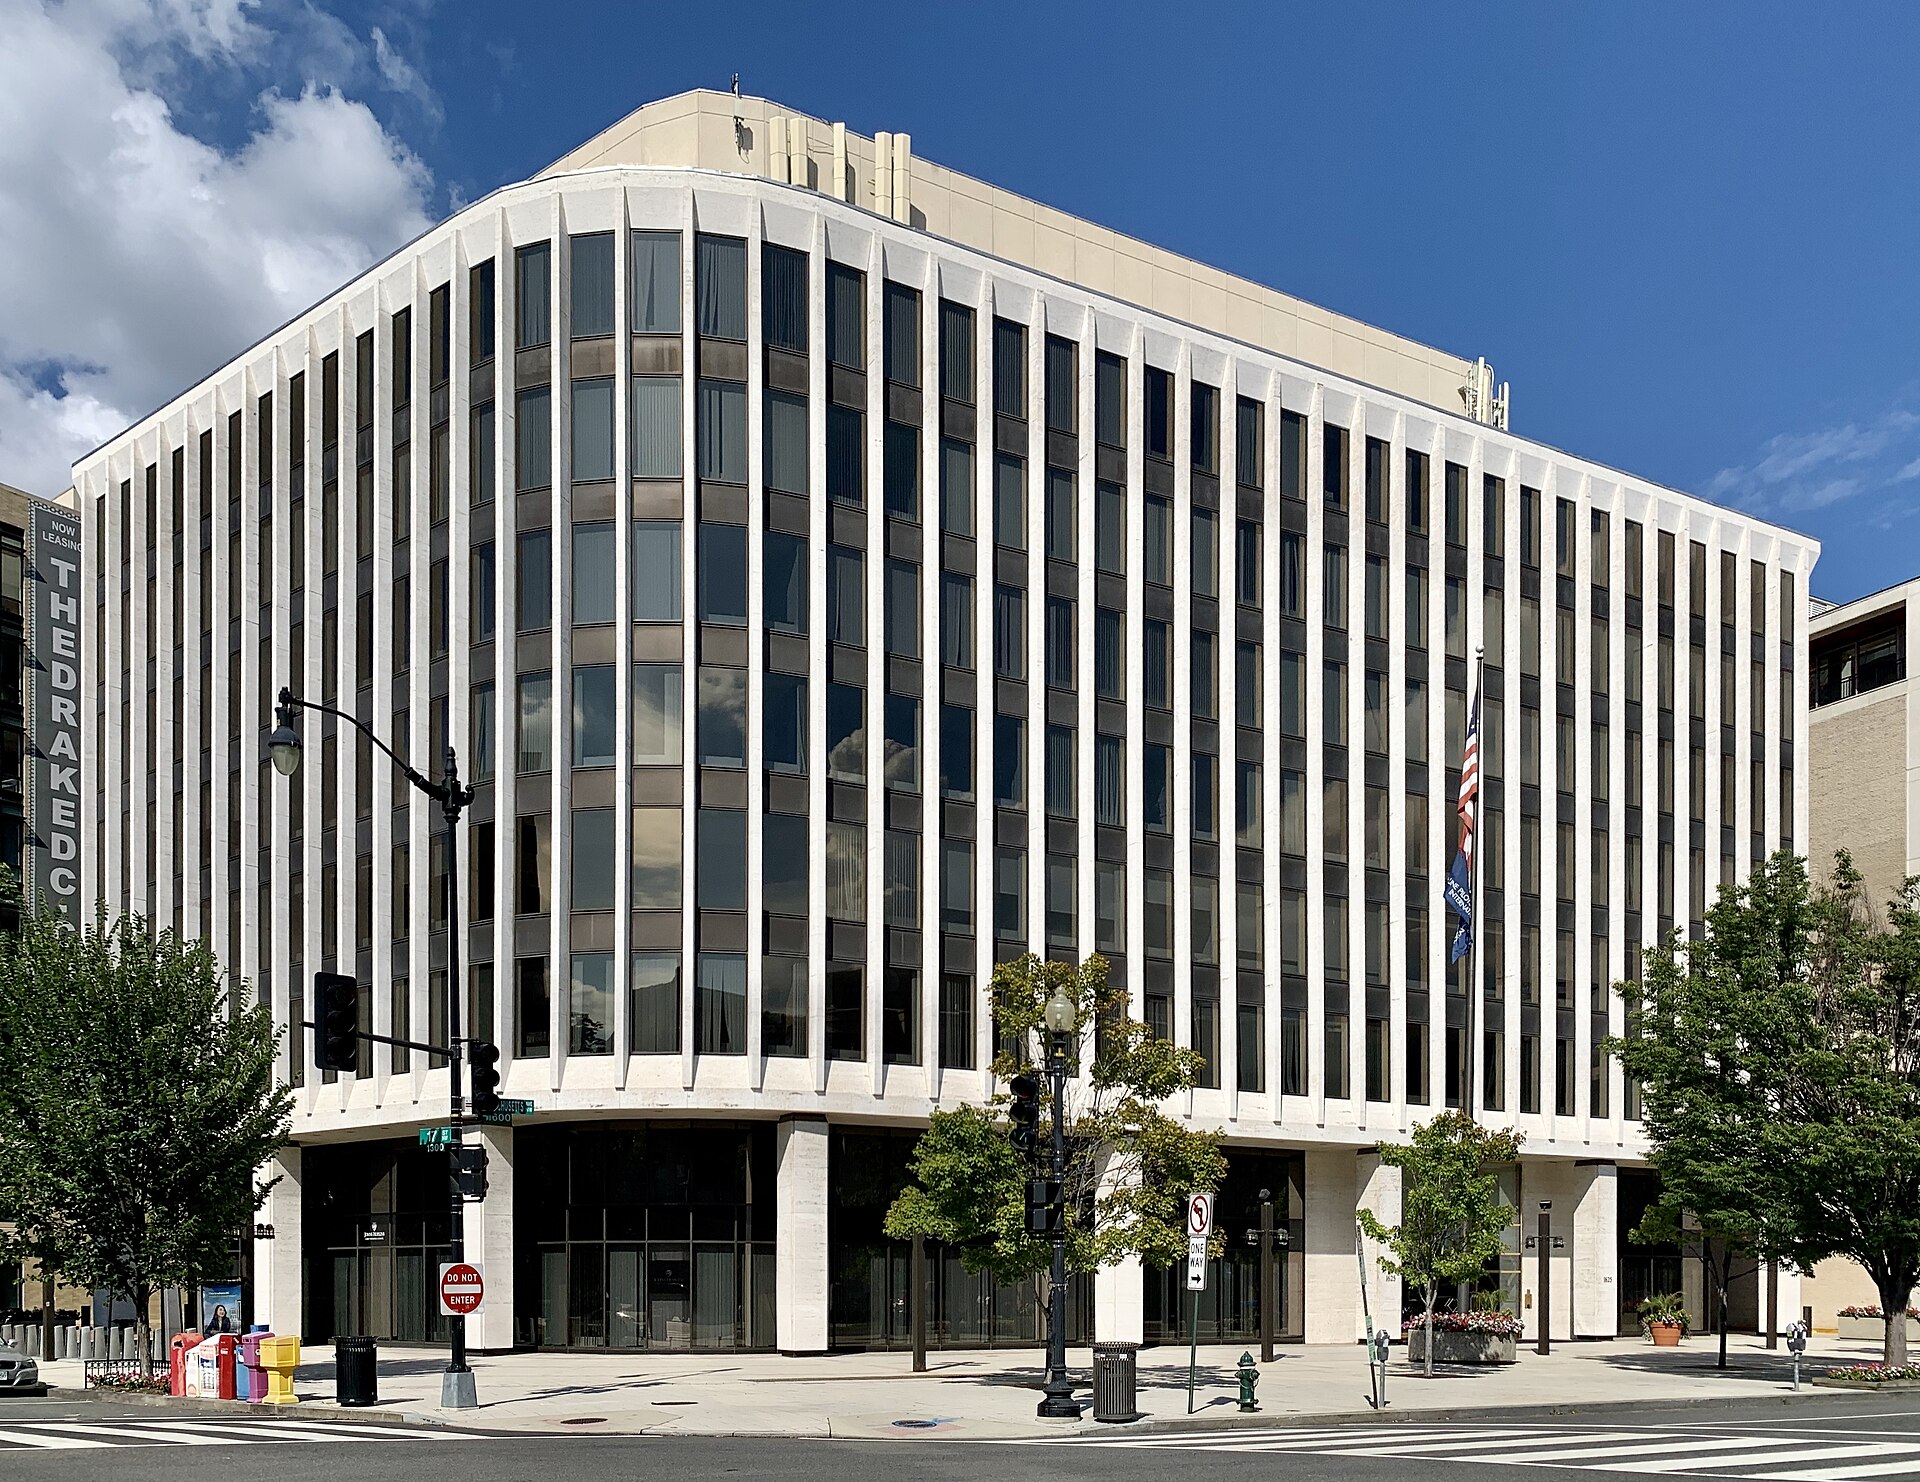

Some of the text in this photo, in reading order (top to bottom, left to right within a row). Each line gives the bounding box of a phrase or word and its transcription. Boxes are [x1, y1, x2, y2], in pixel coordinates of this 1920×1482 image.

[51, 520, 75, 537] NOW
[427, 1130, 438, 1143] 17
[427, 1142, 445, 1153] 1300
[1191, 1243, 1204, 1254] ONE
[1190, 1257, 1204, 1268] WAY
[447, 1273, 478, 1283] DO NOT
[450, 1295, 476, 1305] ENTER
